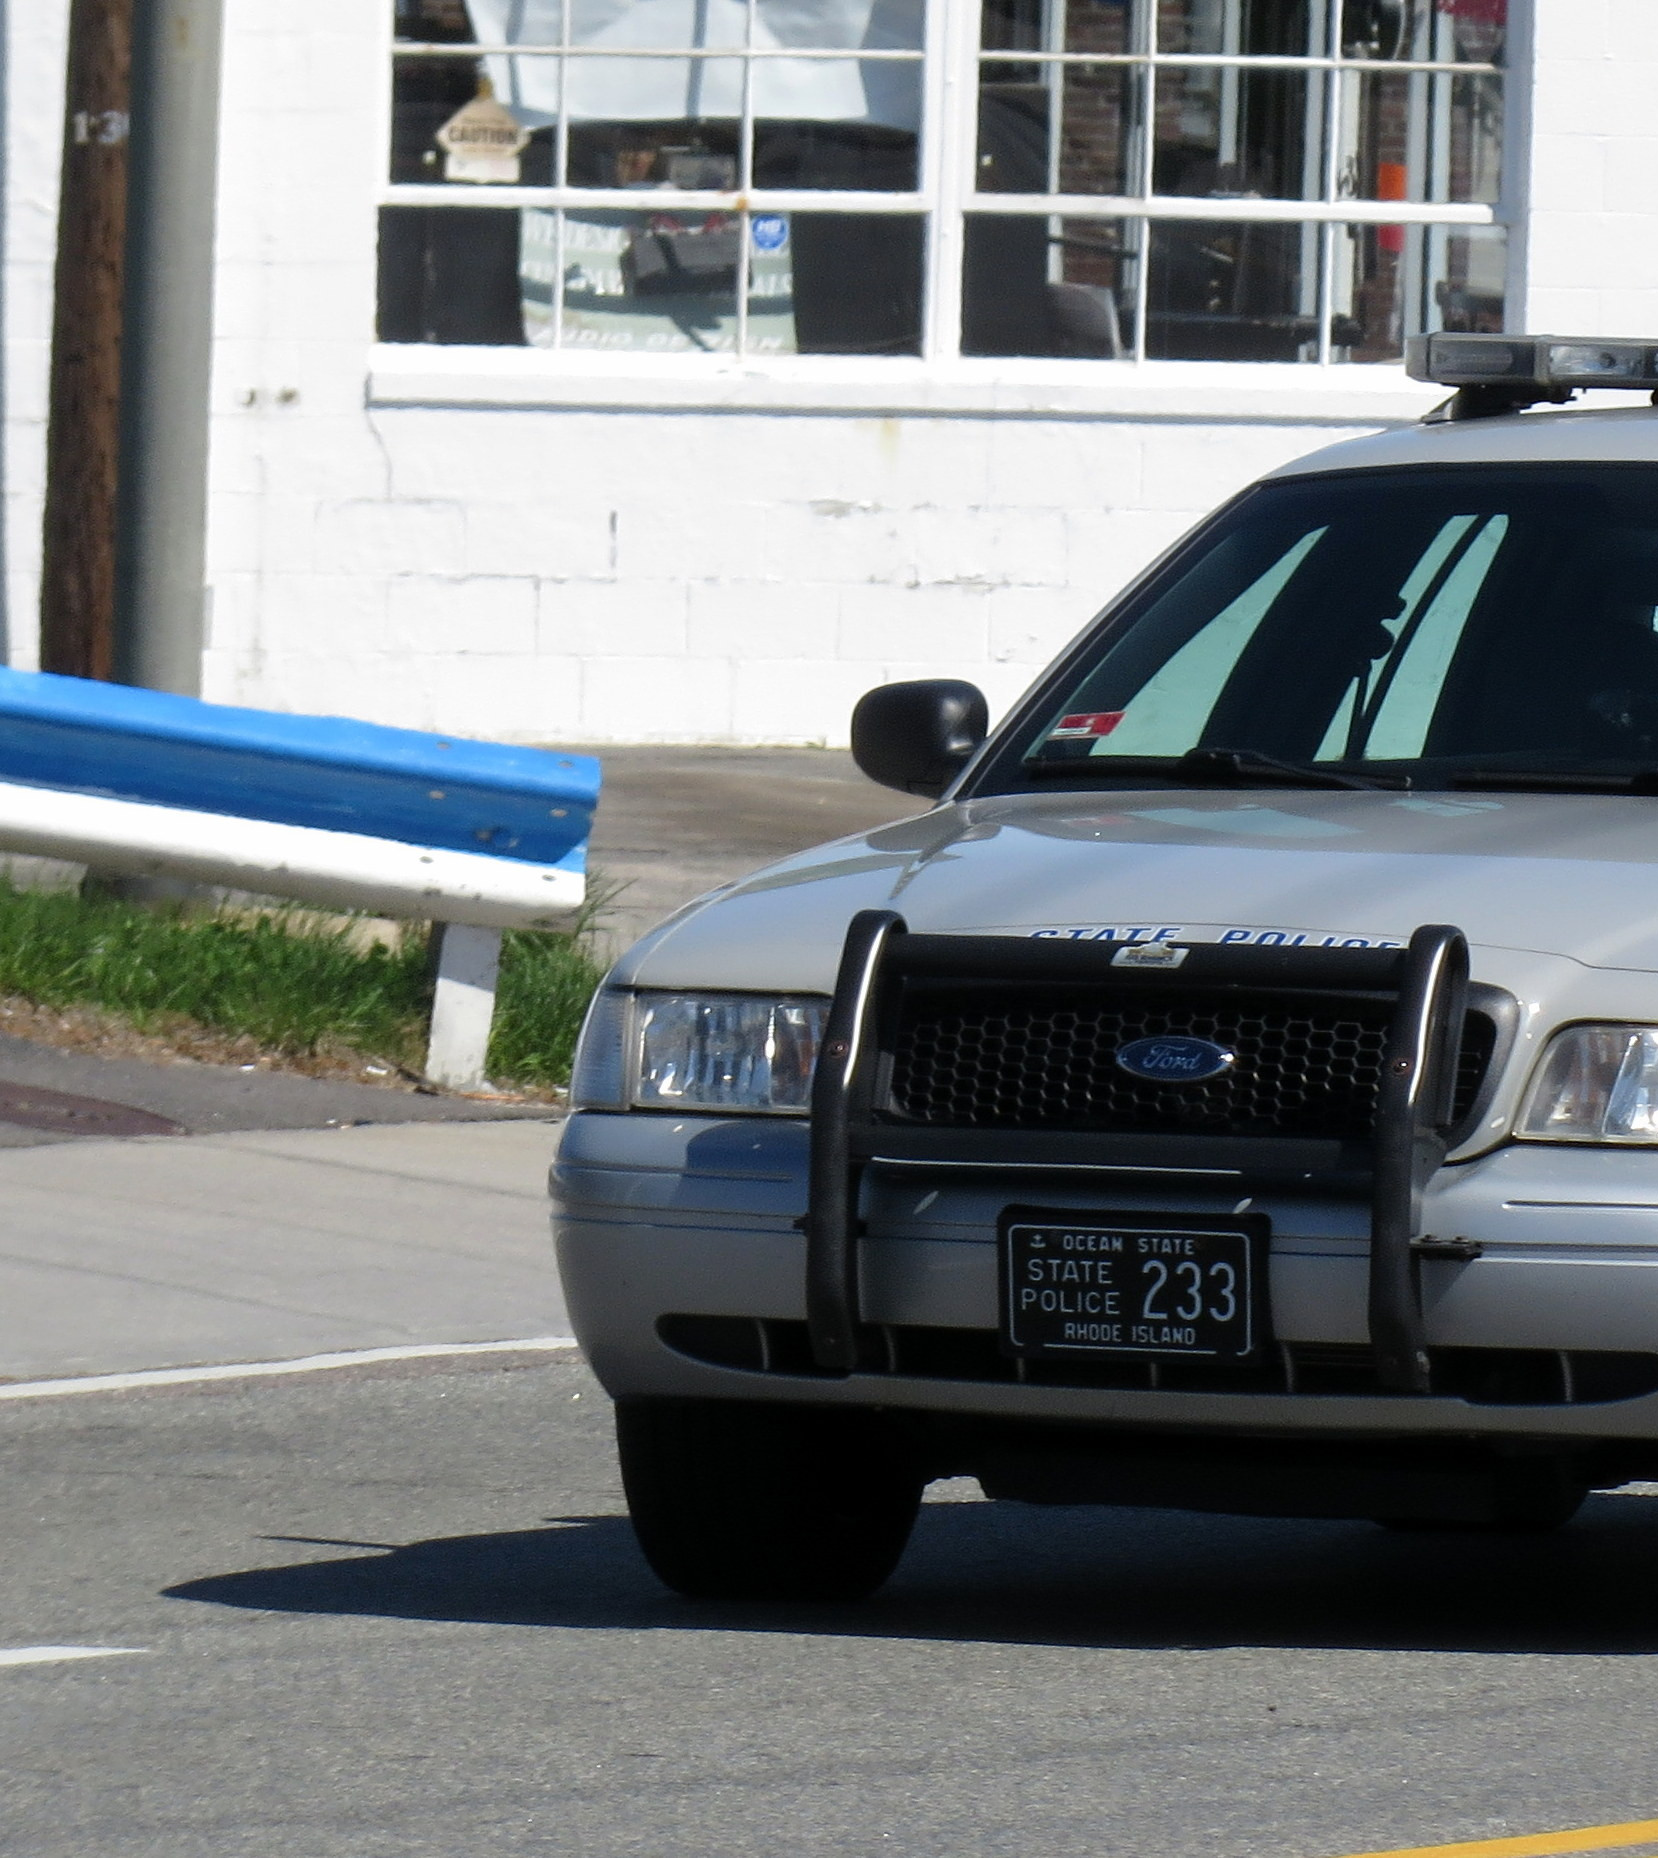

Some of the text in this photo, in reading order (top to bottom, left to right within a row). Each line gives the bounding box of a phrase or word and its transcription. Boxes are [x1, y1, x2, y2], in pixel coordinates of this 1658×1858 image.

[448, 126, 517, 144] CAUTION
[1142, 1043, 1202, 1071] Ford
[1062, 1235, 1195, 1255] OCEAN STATE
[1027, 1258, 1113, 1285] STATE
[1021, 1288, 1121, 1315] POLICE
[1142, 1260, 1236, 1322] 233
[1064, 1322, 1196, 1345] RHODE ISLAND
